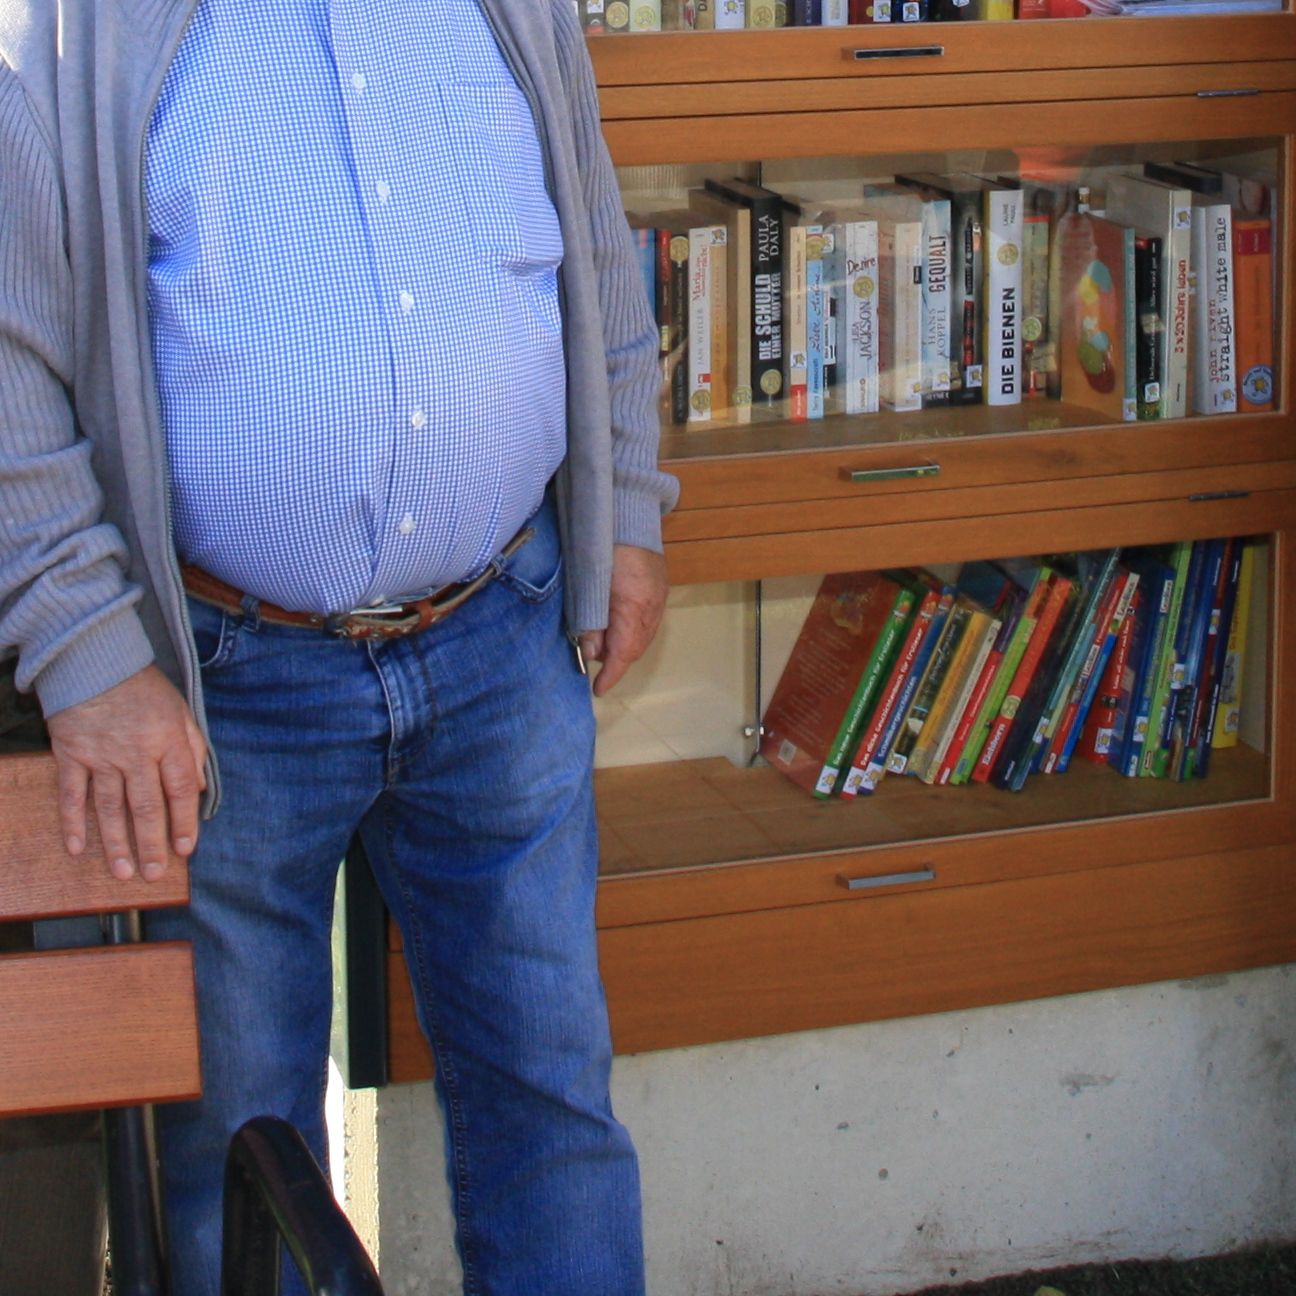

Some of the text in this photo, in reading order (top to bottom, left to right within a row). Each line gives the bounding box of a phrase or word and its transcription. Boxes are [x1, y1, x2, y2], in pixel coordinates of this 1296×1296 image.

[758, 214, 770, 262] PAULA
[769, 217, 779, 257] DALY
[754, 273, 771, 360] DIE SCHULD
[770, 271, 781, 360] EINER MUTTER
[927, 306, 936, 344] HANS
[1215, 217, 1231, 383] straight white male
[696, 308, 705, 366] JAN WEILER
[851, 321, 859, 342] LISA
[859, 299, 873, 360] JACKSON
[935, 306, 946, 357] KOPPEL
[1000, 287, 1016, 394] DIE BIENEN
[1208, 349, 1219, 384] john
[859, 751, 870, 766] Das
